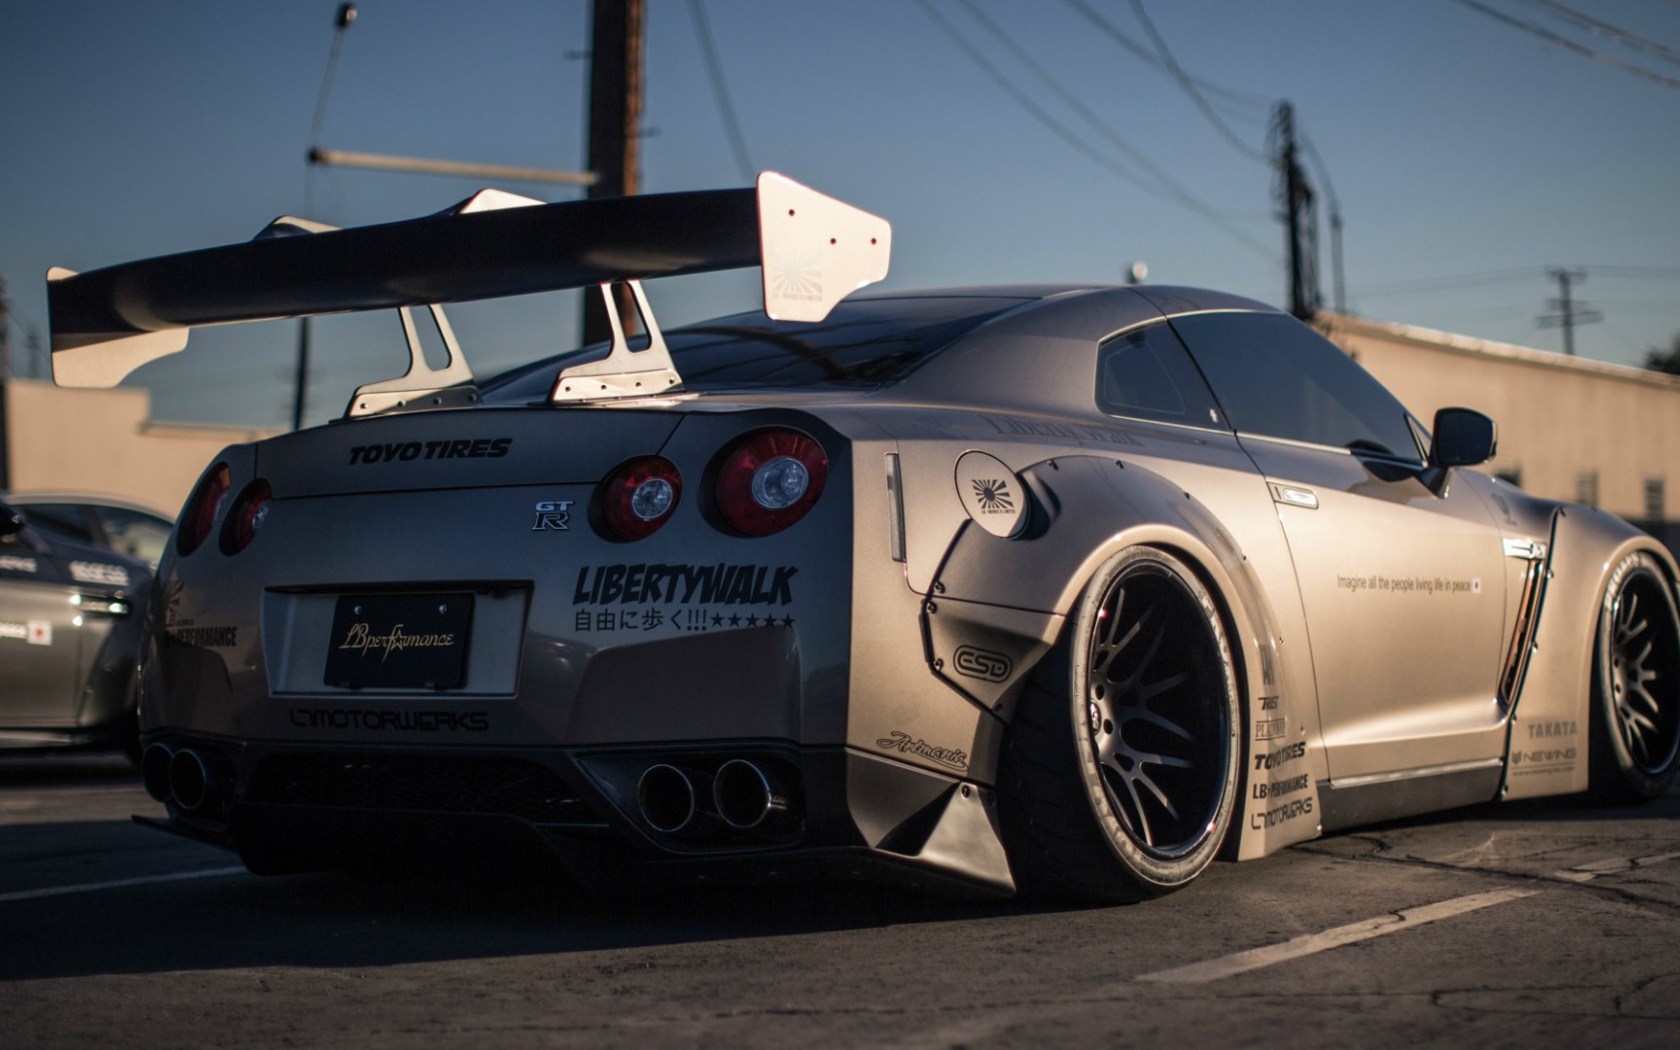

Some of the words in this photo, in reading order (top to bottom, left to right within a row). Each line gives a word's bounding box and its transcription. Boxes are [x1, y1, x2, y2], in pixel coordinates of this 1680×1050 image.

[1337, 574, 1367, 592] Imagine
[1368, 575, 1377, 589] all
[1378, 576, 1390, 590] the
[1391, 577, 1414, 593] people
[1415, 577, 1433, 594] living
[1452, 580, 1472, 593] peace
[1528, 721, 1577, 739] TAKATA
